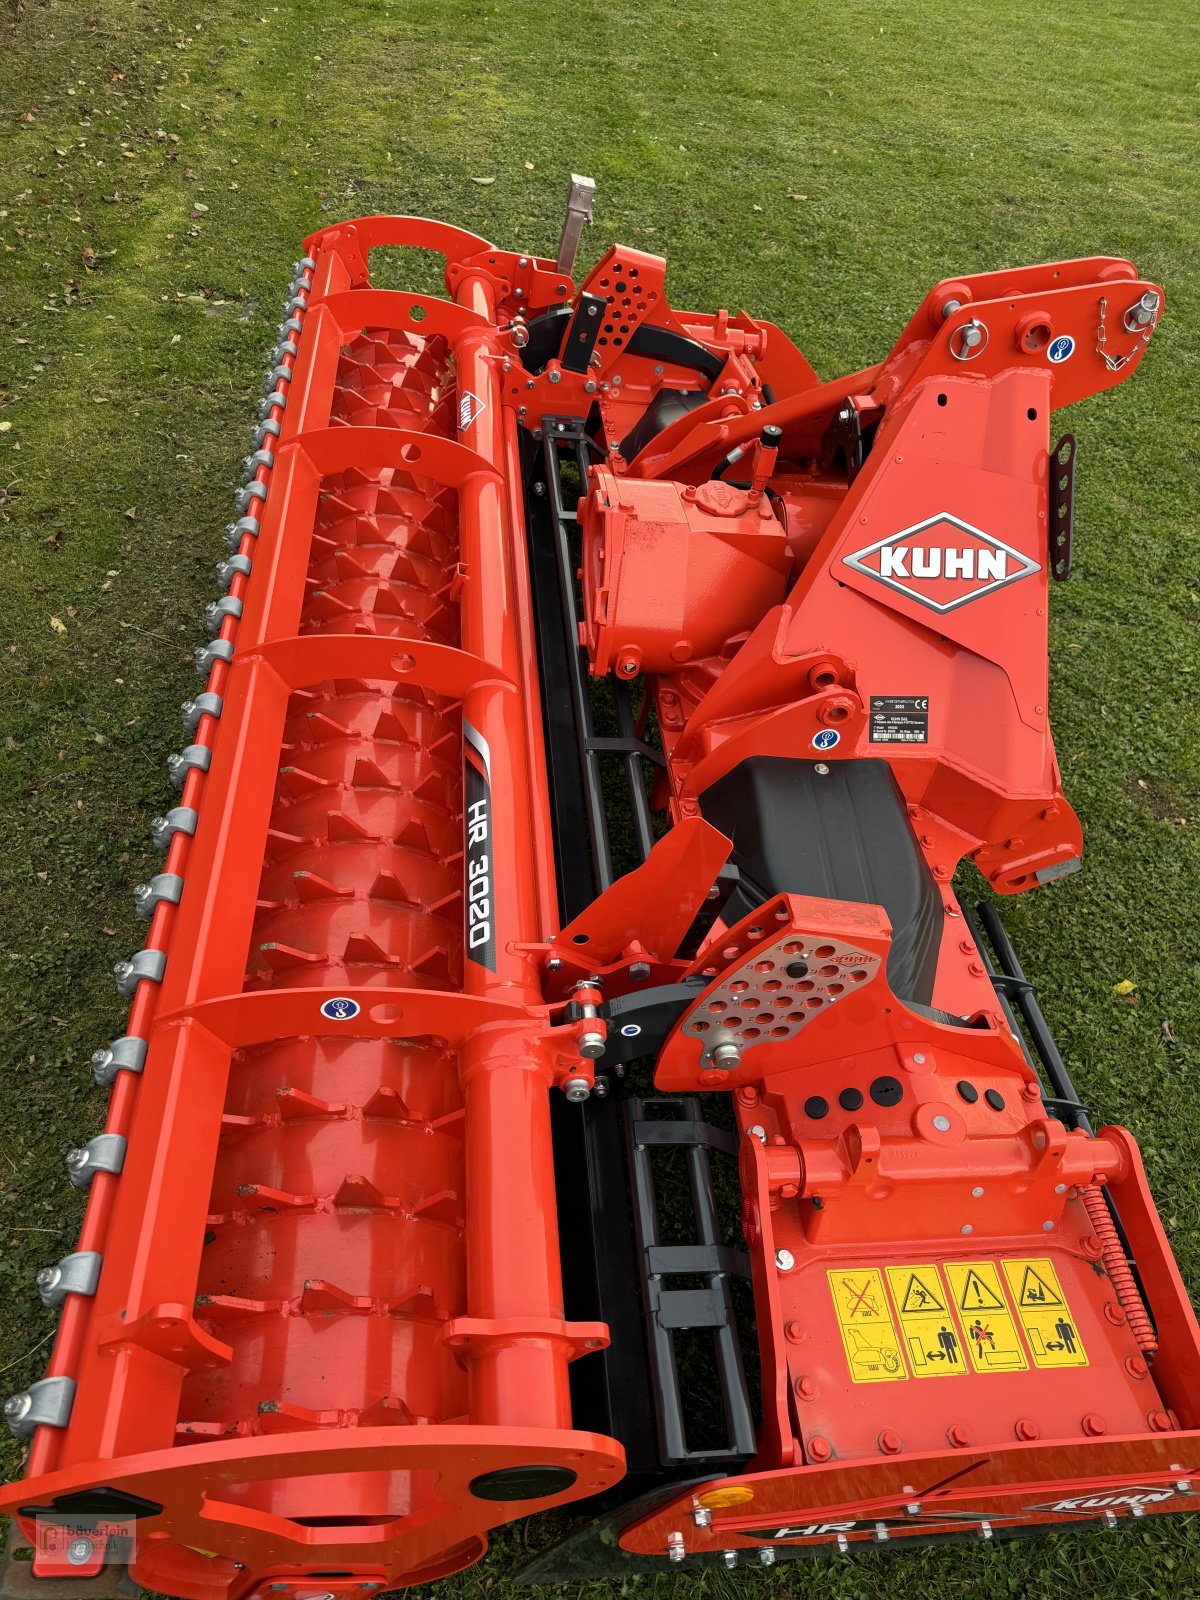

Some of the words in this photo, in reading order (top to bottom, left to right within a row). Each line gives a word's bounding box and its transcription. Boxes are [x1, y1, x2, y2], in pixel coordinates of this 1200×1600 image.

[460, 394, 471, 428] KUHN
[880, 546, 1007, 580] KUHN
[468, 799, 488, 850] HR
[468, 854, 491, 949] 3020
[1050, 1491, 1175, 1511] KUHN
[774, 1521, 857, 1538] HR
